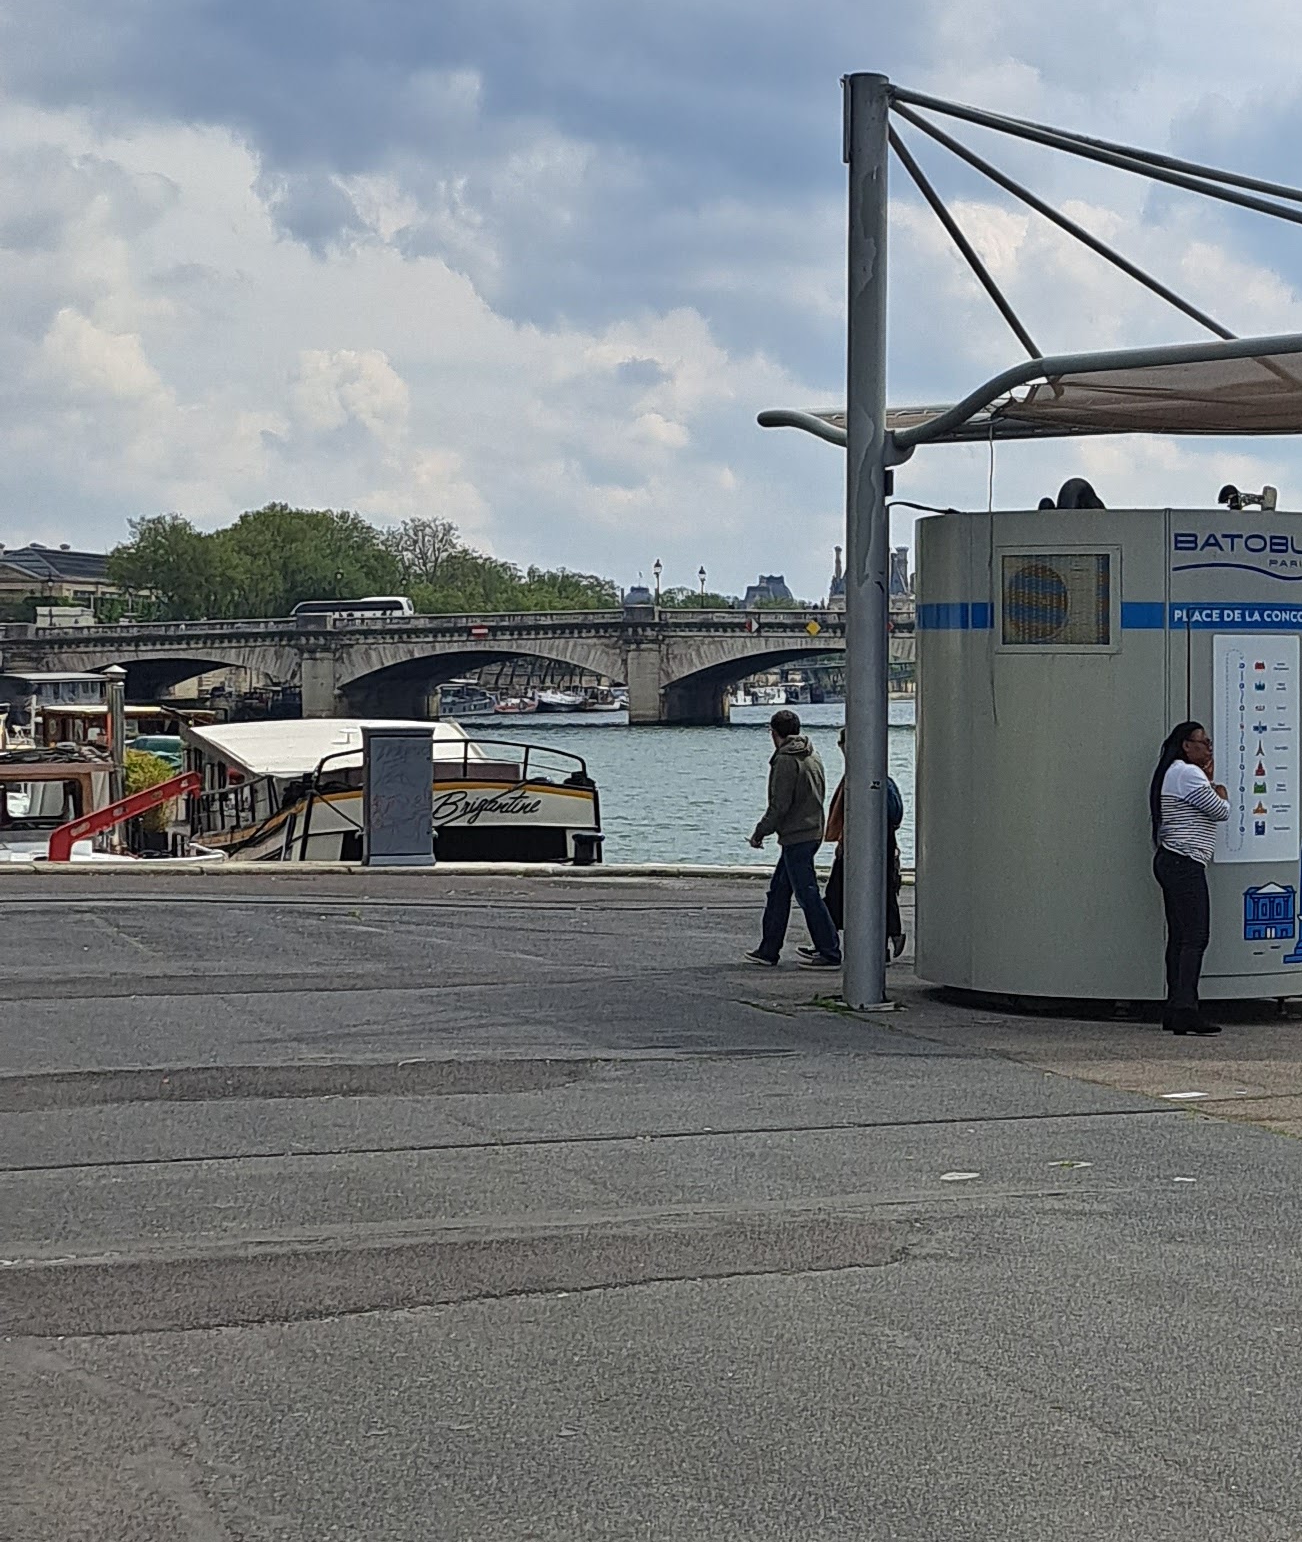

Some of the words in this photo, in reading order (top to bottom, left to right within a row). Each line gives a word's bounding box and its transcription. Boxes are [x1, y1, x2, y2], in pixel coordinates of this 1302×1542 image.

[1173, 609, 1221, 623] PLACE
[1223, 609, 1242, 622] DE
[1245, 609, 1261, 622] LA
[433, 790, 542, 824] Brigantine
